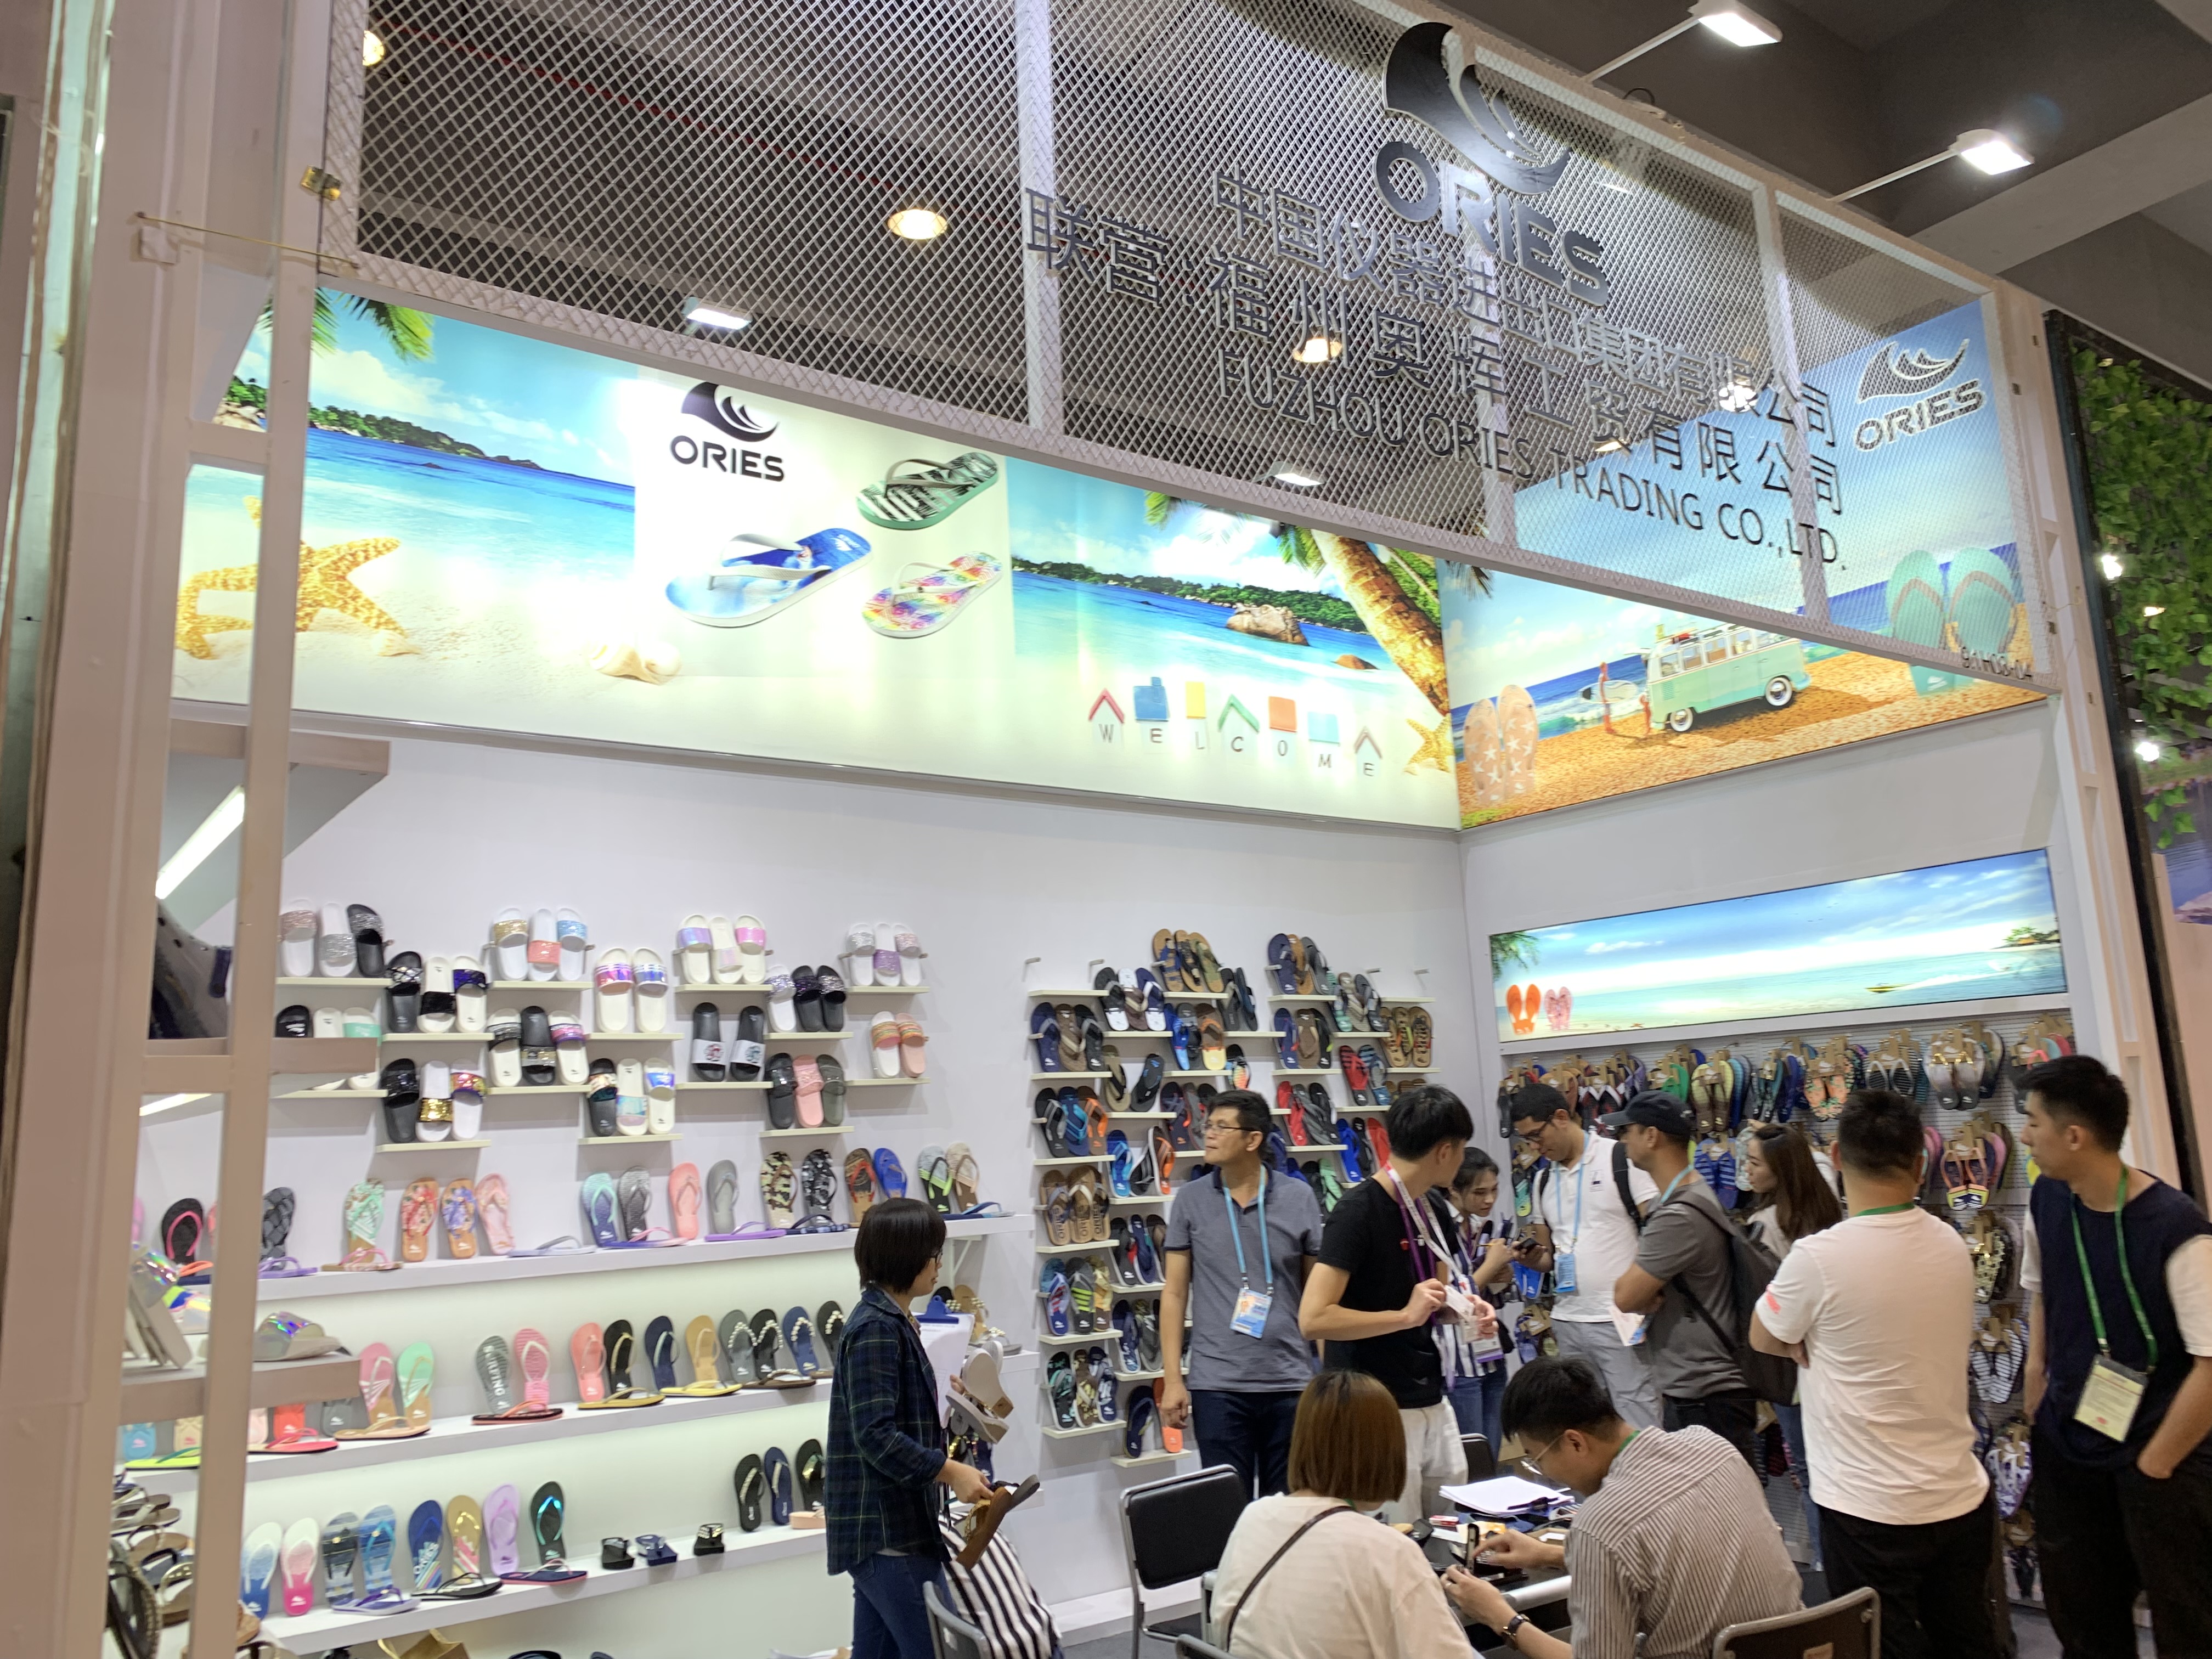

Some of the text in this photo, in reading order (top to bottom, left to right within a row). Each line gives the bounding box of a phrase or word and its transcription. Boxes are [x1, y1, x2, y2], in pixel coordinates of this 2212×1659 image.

[1375, 141, 1609, 307] ORIES
[1218, 349, 1405, 446] FUZHOU
[1425, 413, 1533, 479] ORIES
[1550, 448, 1703, 531] TRADING
[1855, 380, 1984, 451] ORIES
[670, 436, 785, 482] ORIES
[1098, 724, 1374, 776] WELCOME
